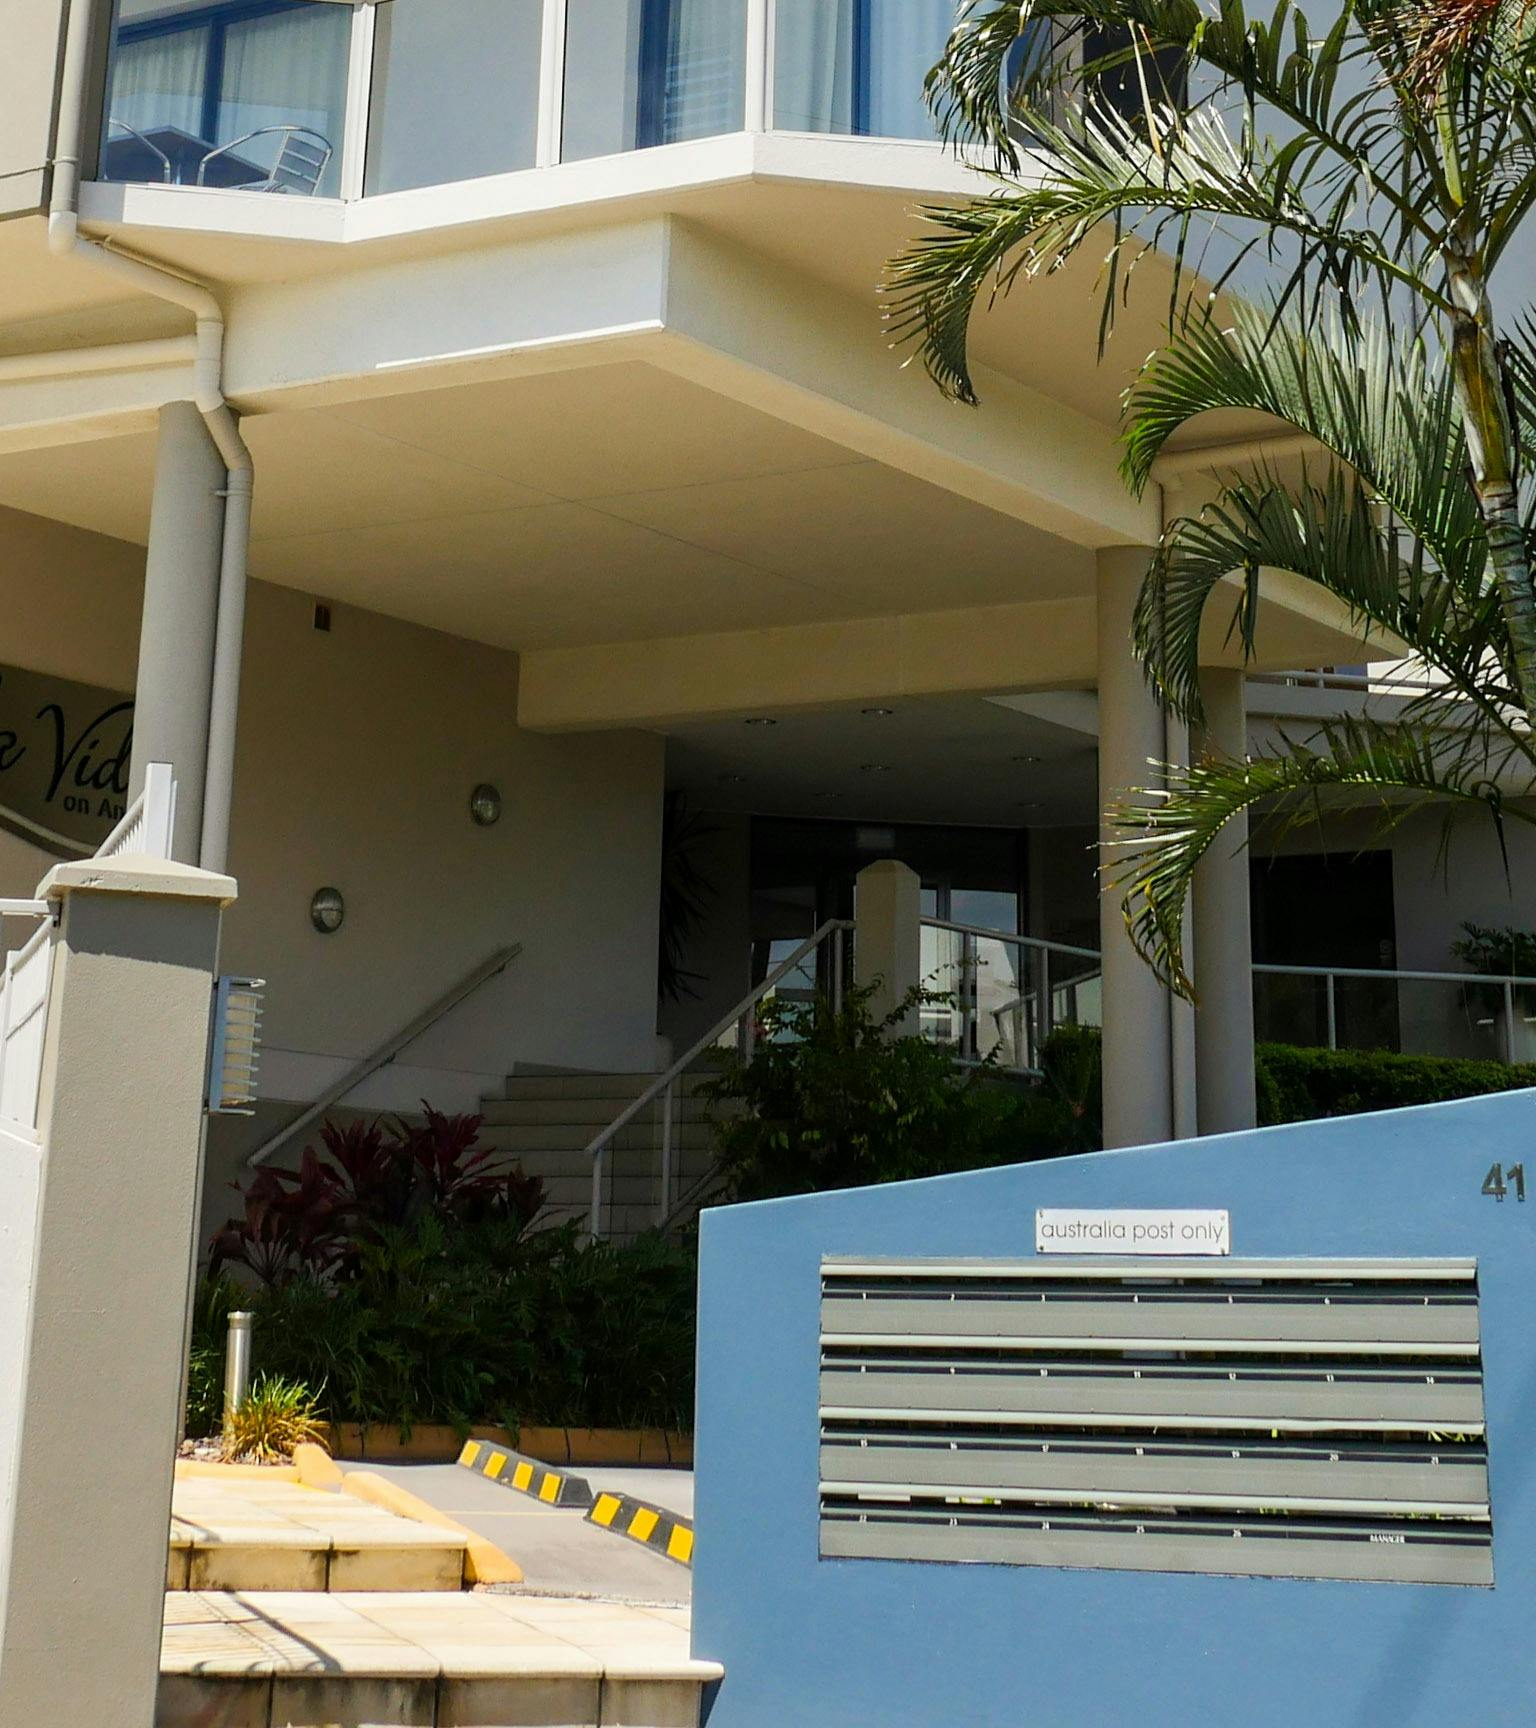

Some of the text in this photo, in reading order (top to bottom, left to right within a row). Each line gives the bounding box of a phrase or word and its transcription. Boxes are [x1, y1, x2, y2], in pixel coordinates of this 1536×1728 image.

[36, 700, 135, 802] Vid
[64, 796, 89, 812] on
[1481, 1162, 1525, 1202] 41
[1041, 1220, 1224, 1243] australia post only
